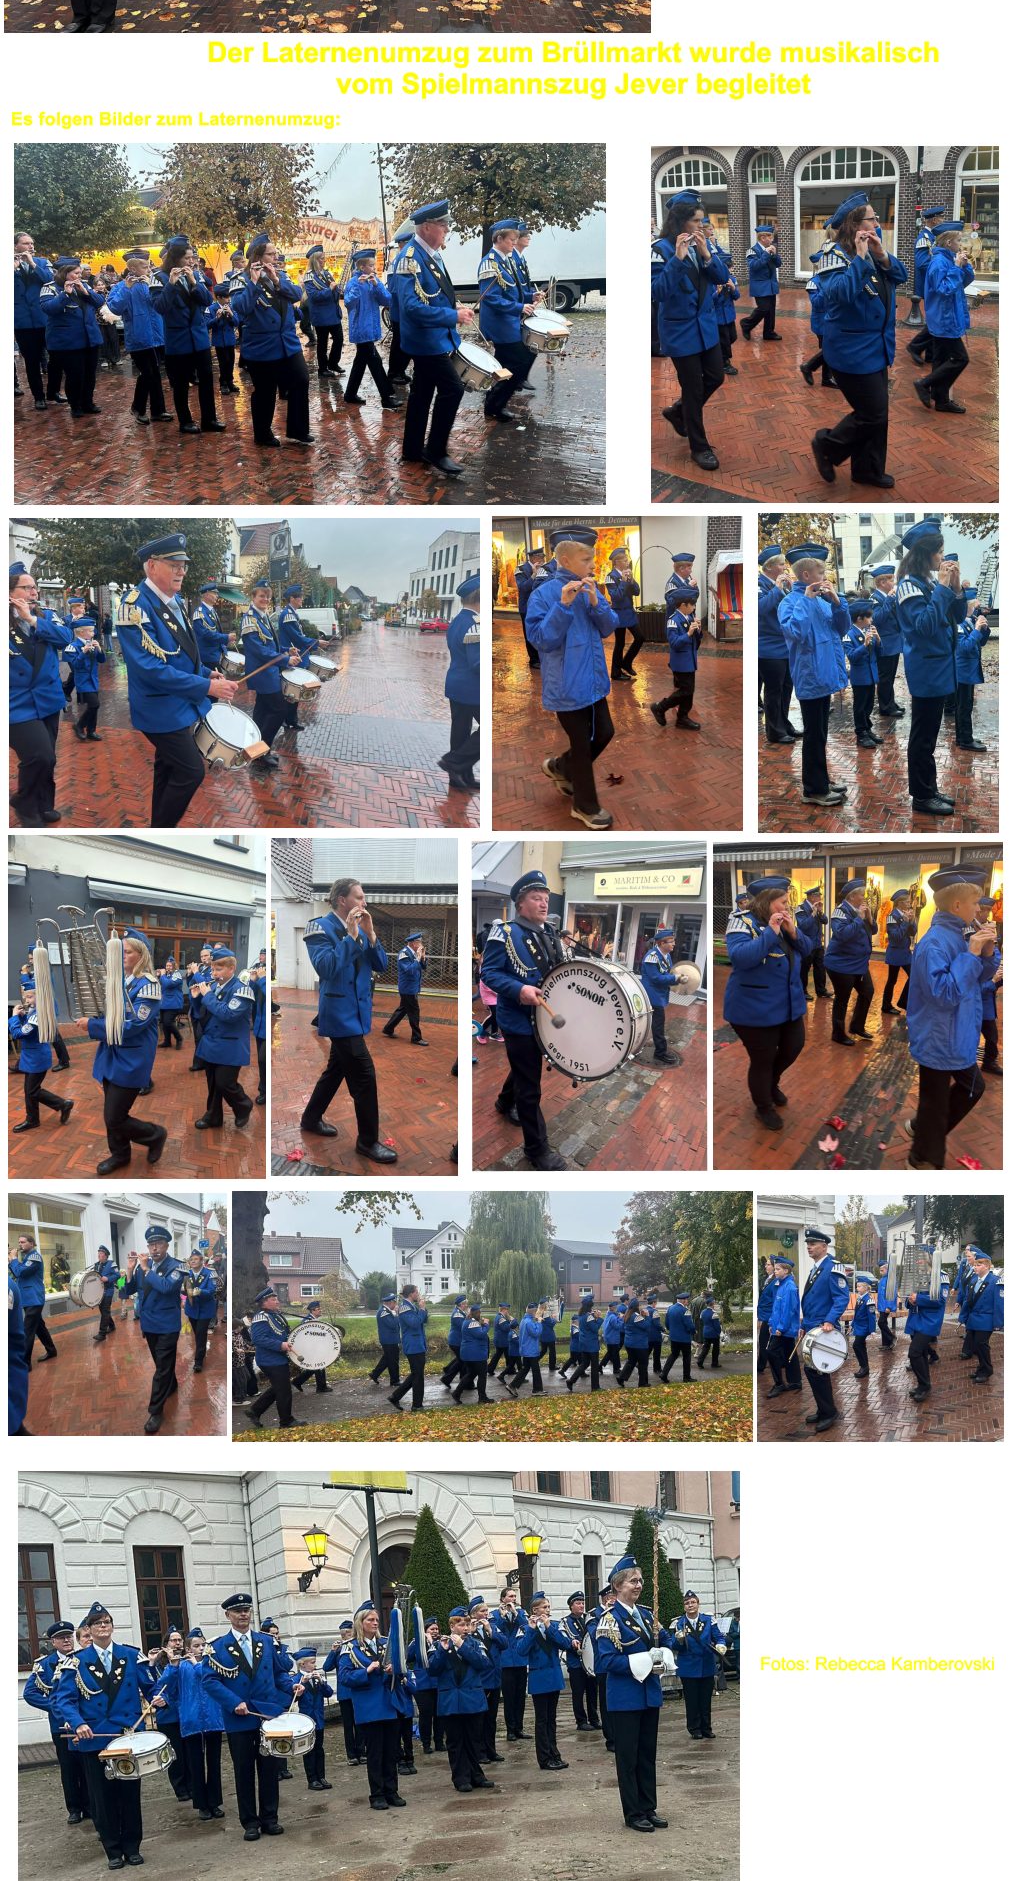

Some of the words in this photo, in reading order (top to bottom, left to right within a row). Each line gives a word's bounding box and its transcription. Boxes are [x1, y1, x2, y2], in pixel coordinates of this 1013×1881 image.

[550, 519, 559, 529] für
[599, 516, 606, 524] B.
[607, 515, 638, 524] Dettmers
[852, 857, 861, 867] für
[863, 856, 876, 864] den
[907, 854, 915, 862] B.
[917, 853, 951, 862] Dettmers
[995, 850, 1004, 860] f
[613, 876, 651, 885] MARITIM
[652, 875, 659, 883] &
[661, 874, 676, 883] CO
[575, 984, 605, 1006] SONOR
[607, 987, 624, 1024] Jever
[611, 1027, 624, 1051] e.V.
[547, 1042, 566, 1063] gegr.
[569, 1059, 590, 1072] 1951
[325, 1327, 337, 1340] Jever
